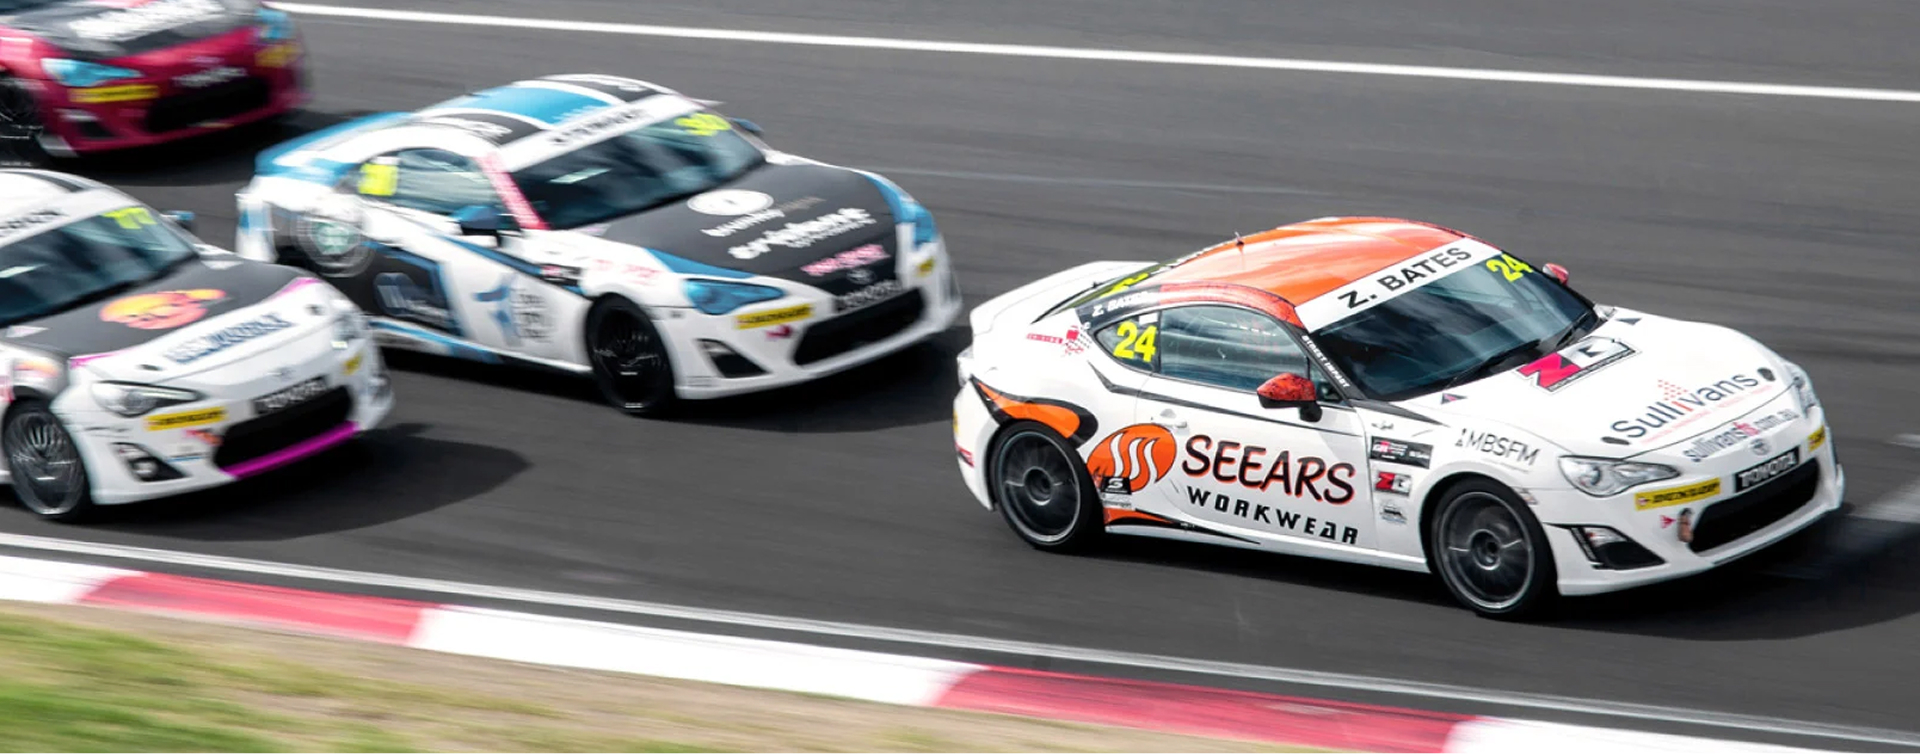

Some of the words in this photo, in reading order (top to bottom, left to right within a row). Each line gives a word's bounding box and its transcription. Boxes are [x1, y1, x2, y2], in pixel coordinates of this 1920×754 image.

[1338, 290, 1378, 309] Z.
[1377, 247, 1472, 291] BATES
[1486, 253, 1533, 283] 24
[1113, 320, 1156, 362] 24
[1610, 372, 1759, 439] Sullivans
[1181, 434, 1356, 505] SEEARS
[1465, 431, 1541, 466] MBSFM
[1738, 451, 1798, 488] TOYOTA
[1186, 485, 1359, 545] WORKWEAR
